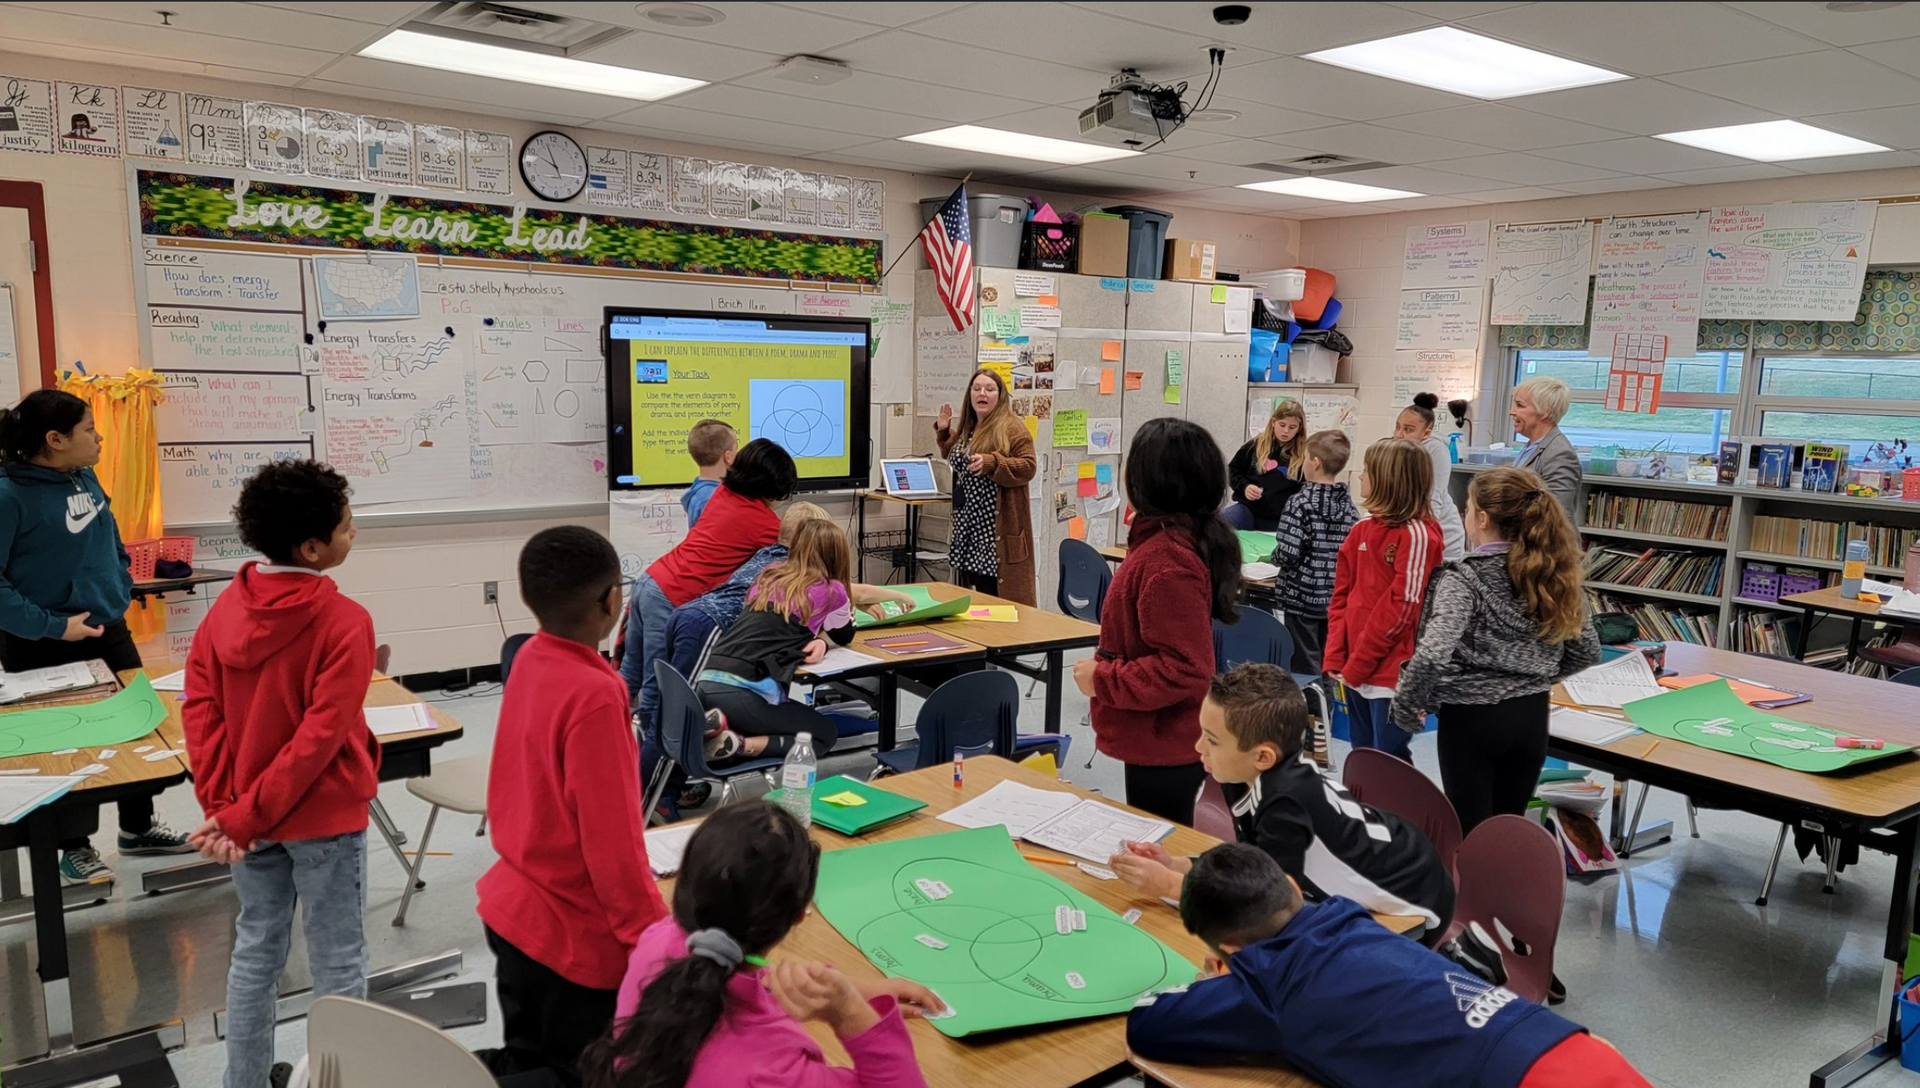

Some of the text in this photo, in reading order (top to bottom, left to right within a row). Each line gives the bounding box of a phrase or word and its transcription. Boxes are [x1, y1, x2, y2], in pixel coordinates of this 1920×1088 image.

[4, 79, 30, 107] Jj
[70, 85, 105, 107] Kk
[136, 90, 168, 110] Ll
[191, 97, 241, 119] Mm
[207, 125, 215, 138] 3
[258, 125, 268, 140] 3
[3, 133, 40, 149] justify
[61, 139, 117, 155] kilogram
[258, 141, 268, 156] 4
[418, 172, 458, 186] quotient
[636, 171, 662, 184] 8.34
[478, 180, 497, 190] ray
[223, 172, 593, 250] Love Learn Lead
[714, 207, 745, 216] variable
[1721, 207, 1749, 217] How do
[1740, 213, 1765, 224] around
[1616, 219, 1637, 230] Earth
[1711, 225, 1721, 233] the
[1725, 224, 1743, 232] world
[1430, 227, 1462, 237] Systems
[1629, 229, 1654, 241] change
[1800, 262, 1813, 270] How
[163, 267, 270, 290] How does energy
[1788, 269, 1822, 277] processes
[172, 282, 223, 297] transform
[1653, 282, 1676, 292] process
[1425, 292, 1456, 301] Patterns
[1774, 289, 1805, 297] processes
[1810, 289, 1827, 298] help
[1781, 294, 1803, 302] notice
[1770, 301, 1802, 310] processes
[1625, 312, 1636, 321] The
[1641, 314, 1664, 322] process
[210, 320, 298, 334] What elements
[494, 316, 584, 334] Angles Lines
[170, 332, 286, 343] help me determine
[323, 330, 417, 349] Energy transfers
[194, 344, 242, 355] the text
[649, 345, 661, 355] CAN
[664, 345, 688, 356] EXPLAIN
[690, 346, 700, 356] THE
[701, 346, 737, 357] DIFFERENCES
[739, 348, 763, 357] BETWEEN
[790, 349, 808, 358] DRAMA
[809, 350, 821, 358] AND
[1417, 352, 1453, 360] Structures
[673, 370, 710, 379] Your Task
[208, 378, 260, 390] What can
[219, 394, 299, 409] in my opinion
[324, 387, 417, 407] Energy Transforms
[702, 392, 727, 401] diagram
[182, 404, 283, 418] that will make a
[641, 402, 669, 410] compare
[642, 440, 657, 448] type
[243, 451, 263, 460] are
[185, 464, 228, 477] able to
[212, 480, 221, 488] a
[170, 606, 190, 616] line
[1022, 976, 1056, 1000] Drama
